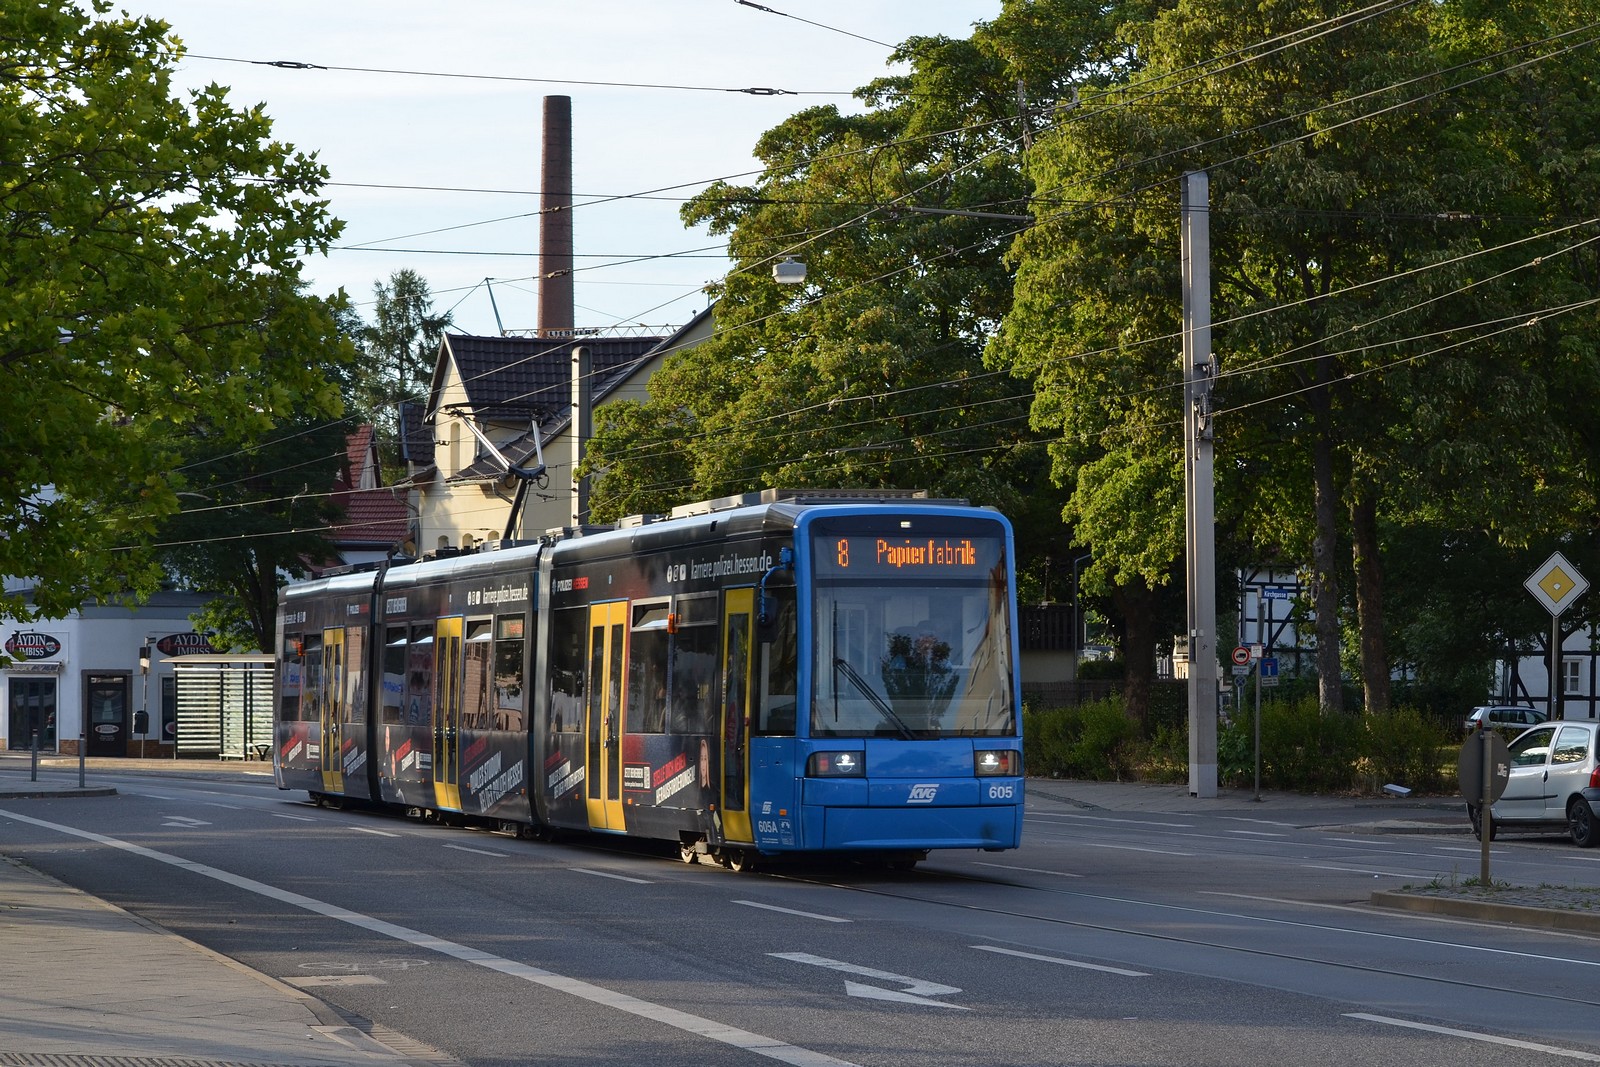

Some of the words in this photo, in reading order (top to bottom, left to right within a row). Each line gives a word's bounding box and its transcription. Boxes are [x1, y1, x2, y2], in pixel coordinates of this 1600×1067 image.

[838, 540, 848, 567] 8
[877, 539, 976, 568] Papierfabrik
[691, 549, 773, 582] karriere.polizei.hessen.de
[557, 579, 573, 592] POLIZEI
[1264, 591, 1286, 599] Kirchgasse
[17, 635, 46, 646] AYDIN
[19, 647, 44, 656] IMBISS
[989, 786, 1013, 799] 605
[758, 820, 779, 833] 605A
